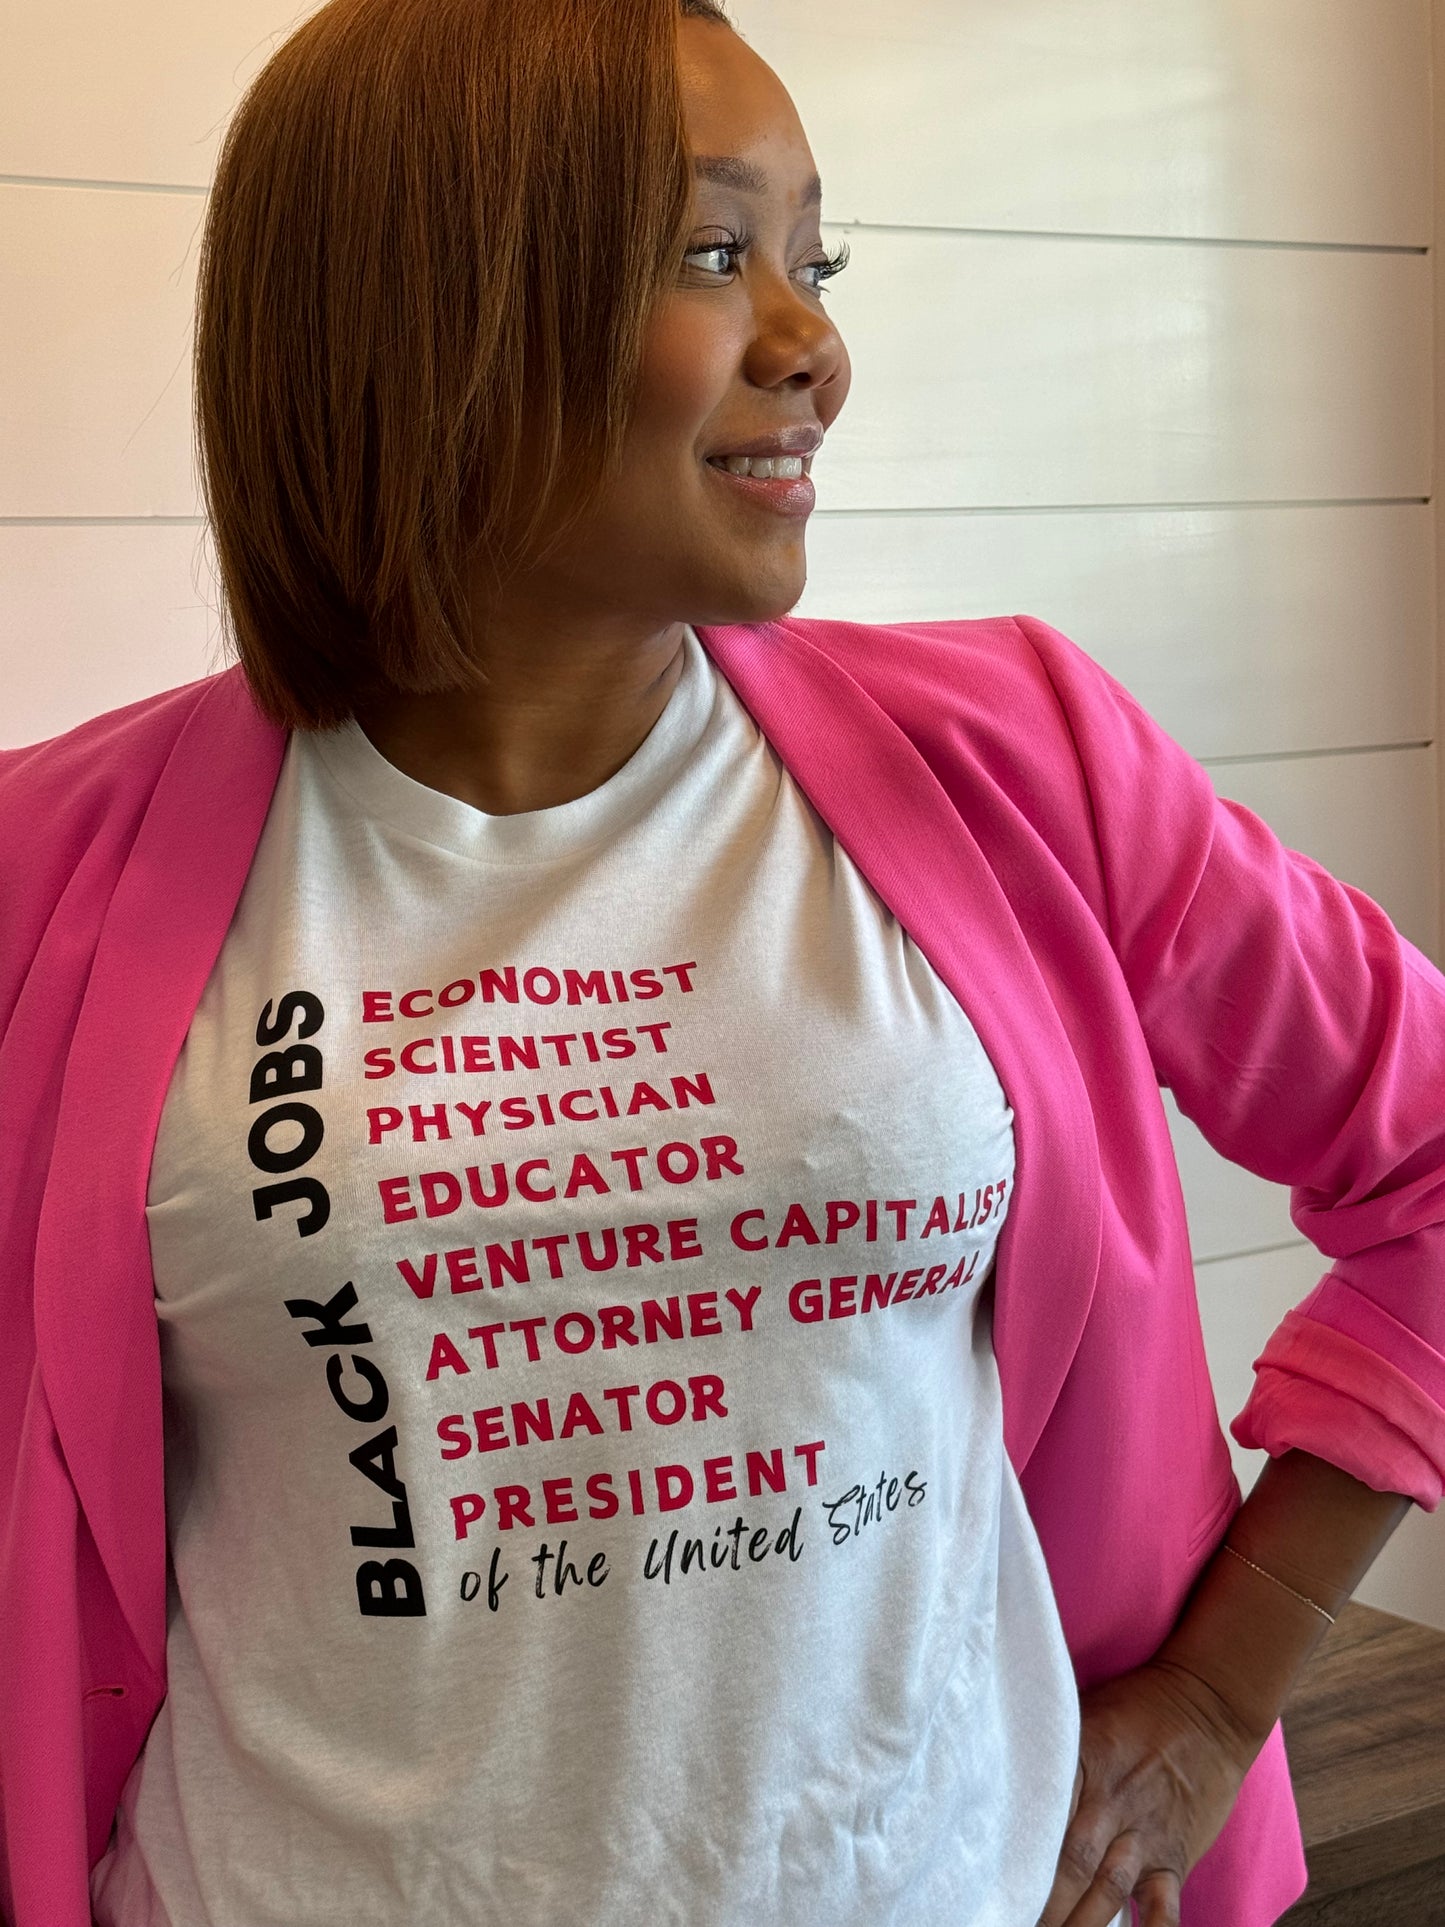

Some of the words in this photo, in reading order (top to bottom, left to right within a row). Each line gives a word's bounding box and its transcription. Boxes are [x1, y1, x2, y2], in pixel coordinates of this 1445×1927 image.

[362, 962, 697, 1022] ECONOMIST
[363, 1022, 672, 1079] SCIENTIST
[247, 991, 331, 1237] JOBS
[367, 1073, 716, 1144] PHYSICIAN
[378, 1135, 744, 1225] EDUCATOR
[397, 1218, 702, 1300] VENTURE
[731, 1179, 1007, 1252] CAPITALIST
[426, 1286, 761, 1380] ATTORNEY
[789, 1250, 980, 1323] GENERAL
[283, 1280, 428, 1616] BLACK
[437, 1375, 729, 1460] SENATOR
[449, 1441, 825, 1540] PRESIDENT
[459, 1547, 508, 1612] of
[532, 1541, 610, 1603] the
[643, 1508, 804, 1583] United
[823, 1469, 927, 1541] States
